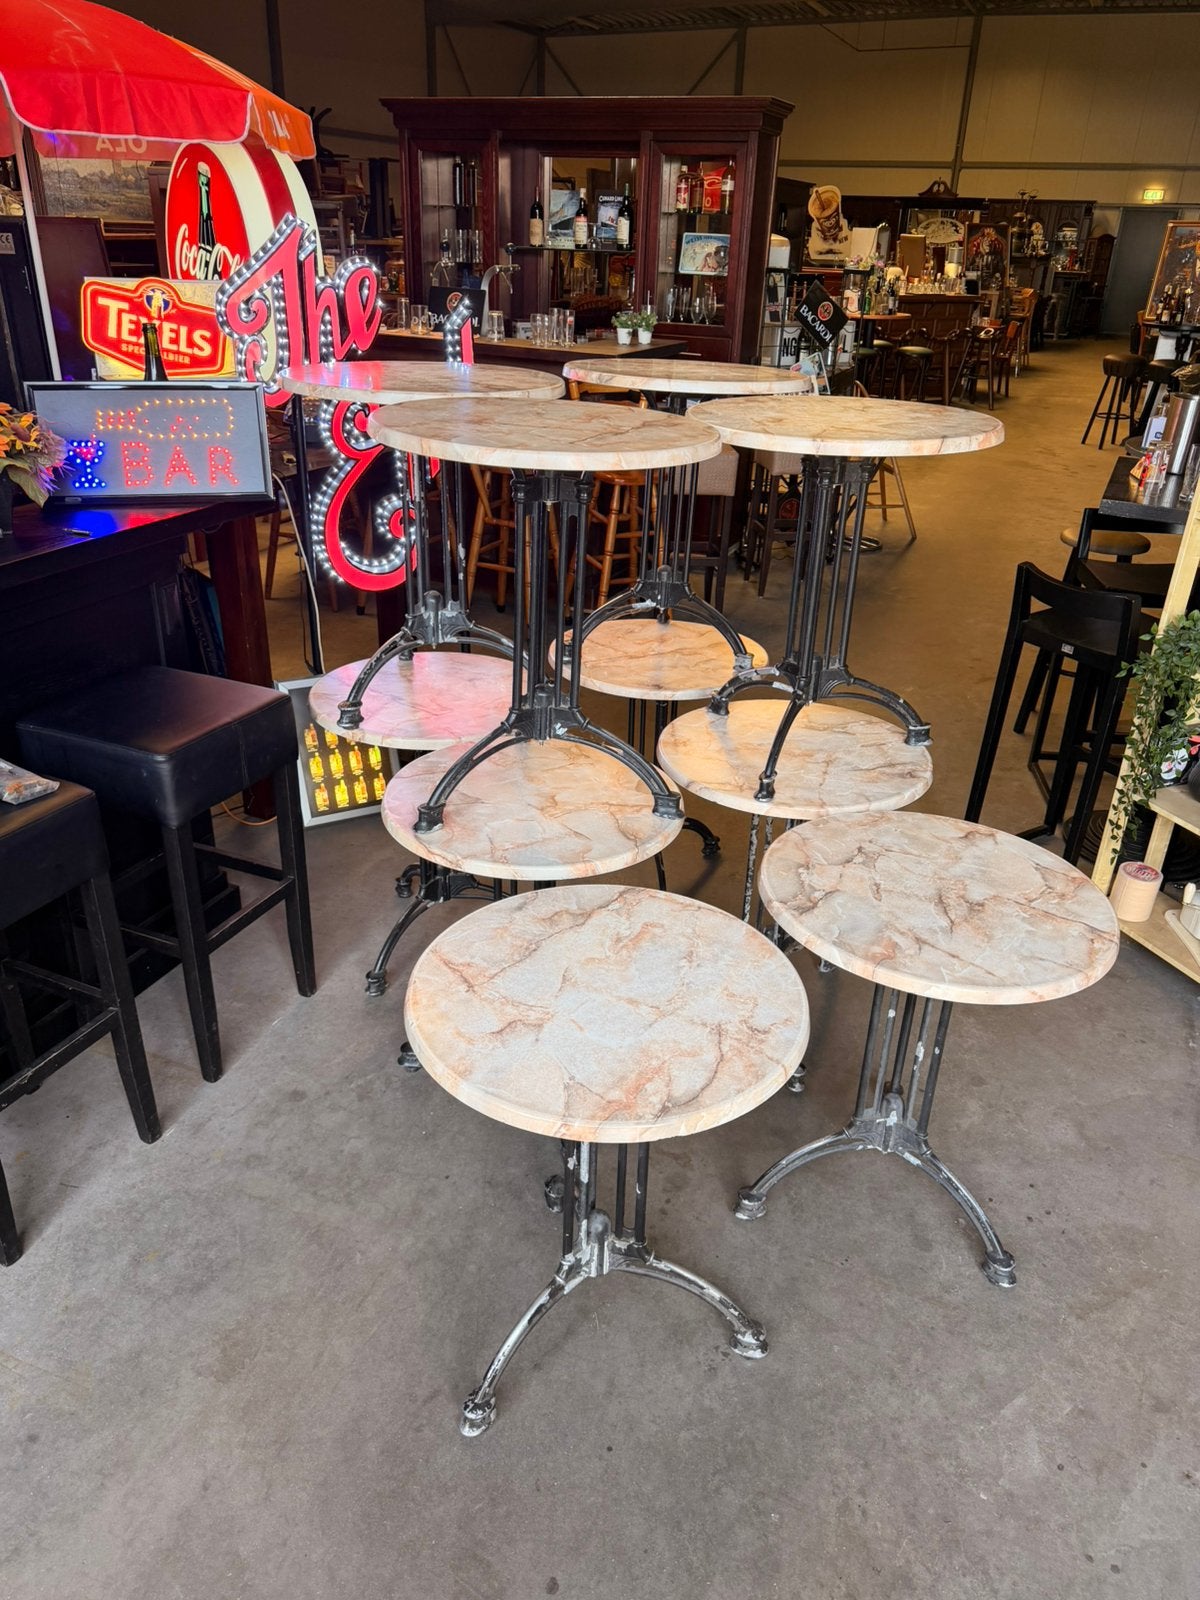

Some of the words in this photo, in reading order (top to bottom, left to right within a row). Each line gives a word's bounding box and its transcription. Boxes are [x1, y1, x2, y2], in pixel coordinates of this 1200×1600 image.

[175, 223, 246, 280] Coca-C
[216, 212, 384, 408] The
[430, 312, 480, 328] BACI
[799, 304, 833, 342] BACARDI
[120, 343, 191, 365] SPECLBIER
[120, 440, 241, 488] BAR
